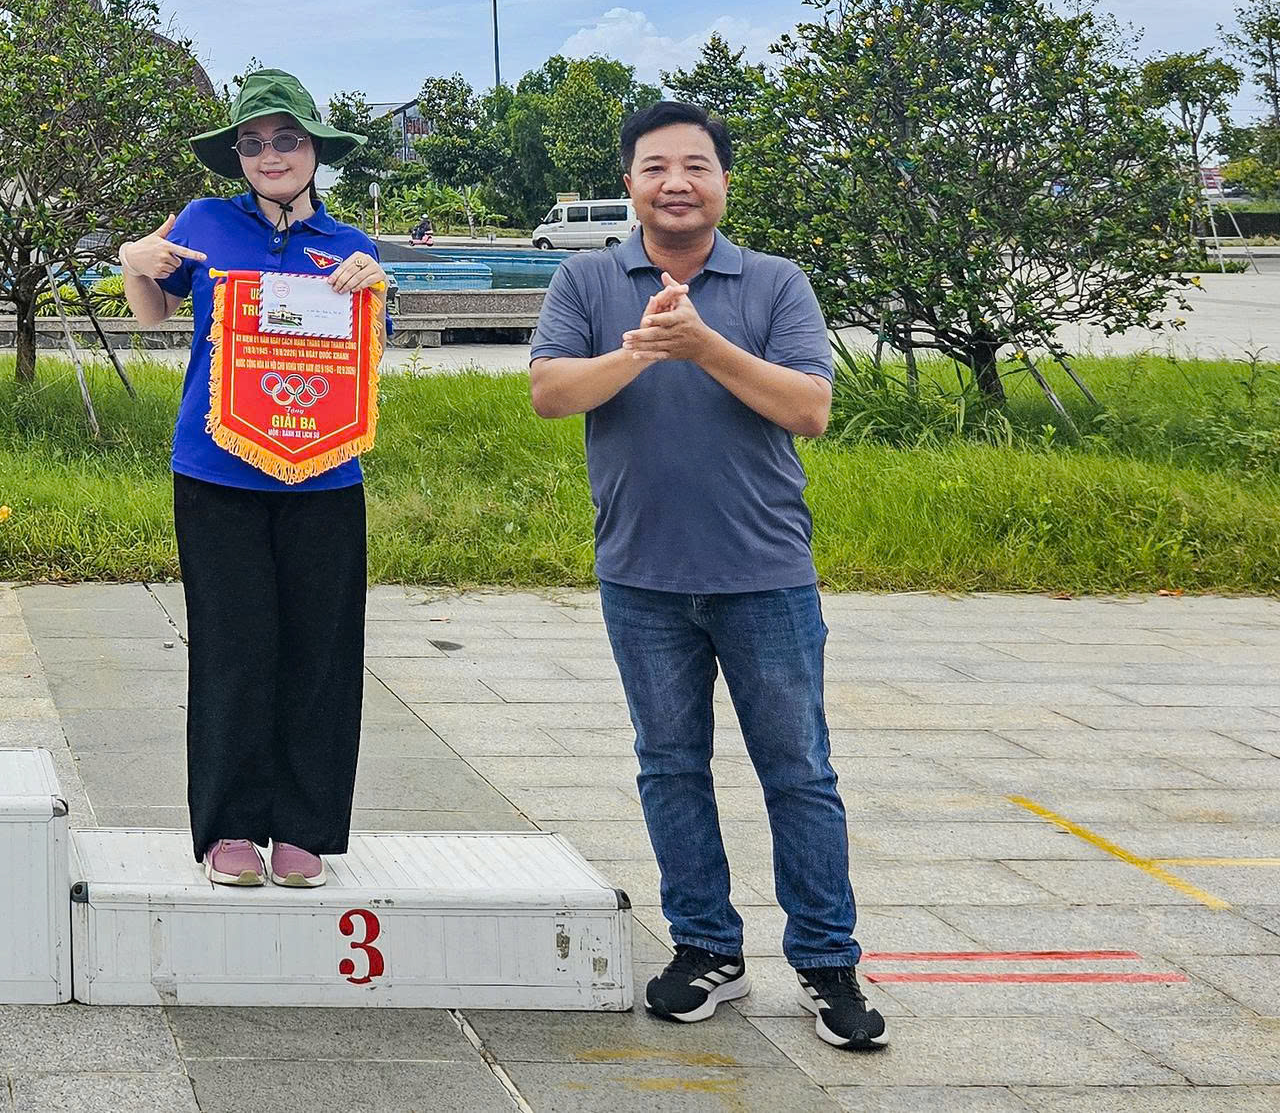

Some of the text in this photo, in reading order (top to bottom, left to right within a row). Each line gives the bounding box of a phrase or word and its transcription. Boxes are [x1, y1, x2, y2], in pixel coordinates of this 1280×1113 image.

[272, 413, 316, 430] GIẢI BA
[340, 908, 385, 984] 3
